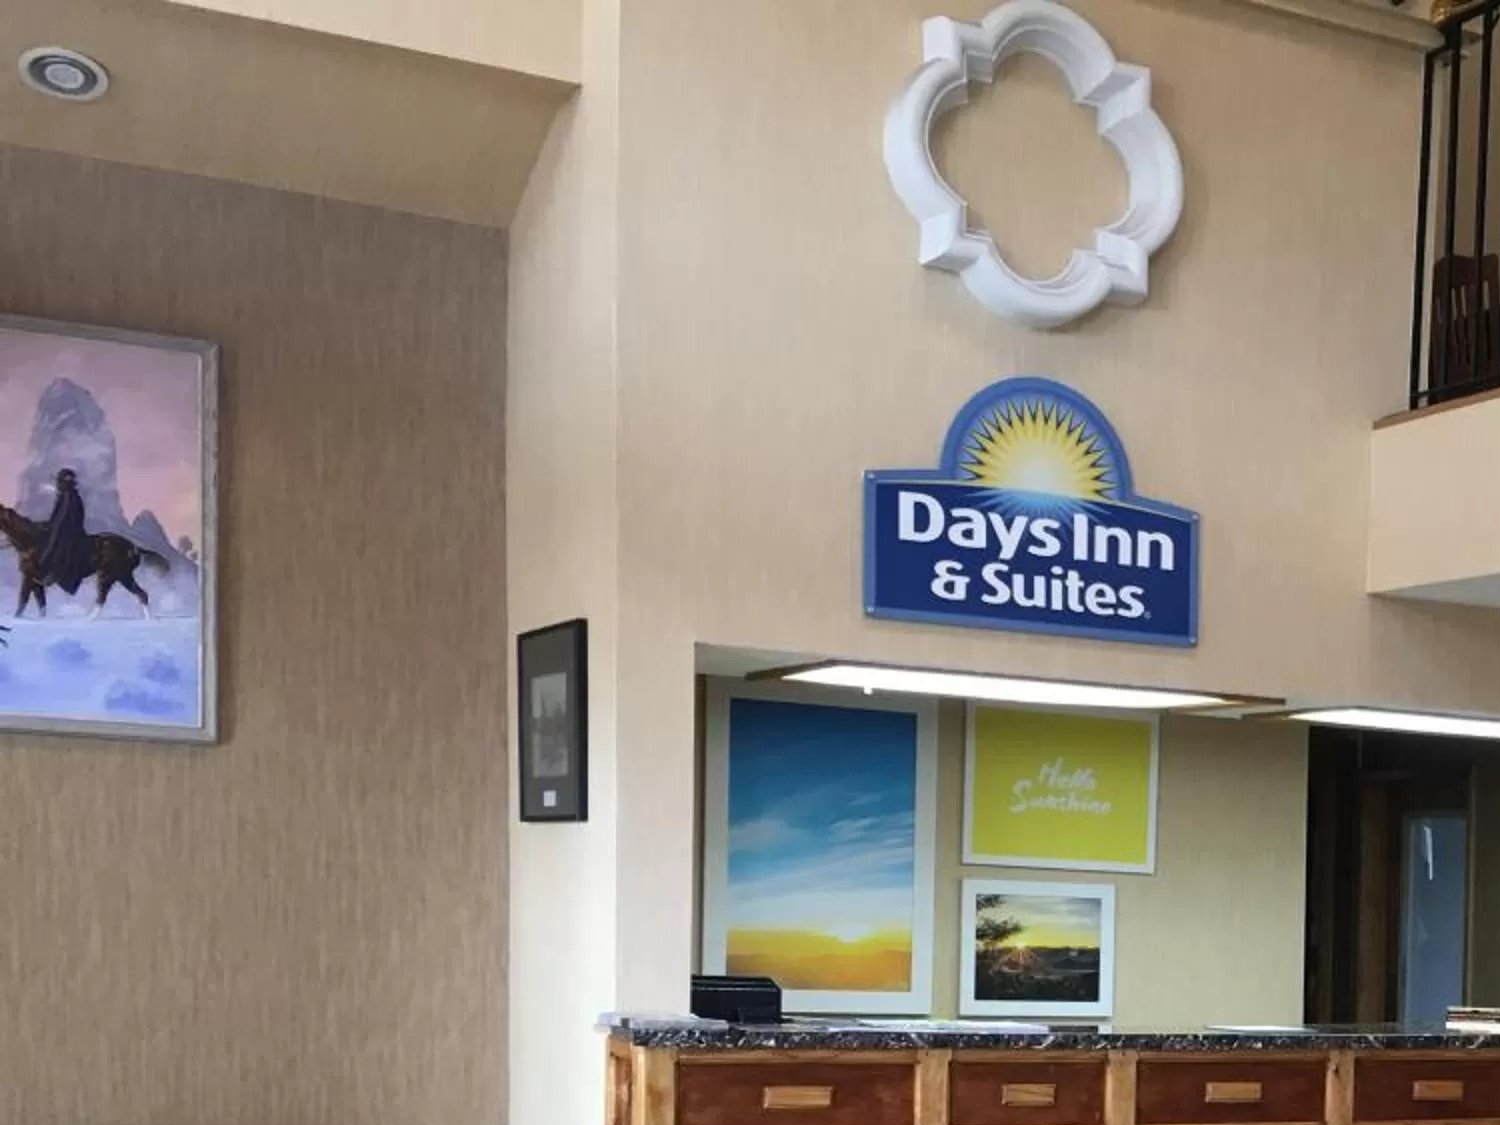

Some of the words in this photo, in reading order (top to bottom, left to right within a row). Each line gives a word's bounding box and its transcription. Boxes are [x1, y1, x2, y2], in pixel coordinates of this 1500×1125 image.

[898, 491, 1061, 560] Days
[1073, 513, 1175, 571] Inn
[930, 560, 971, 601] &
[981, 563, 1146, 619] Suites
